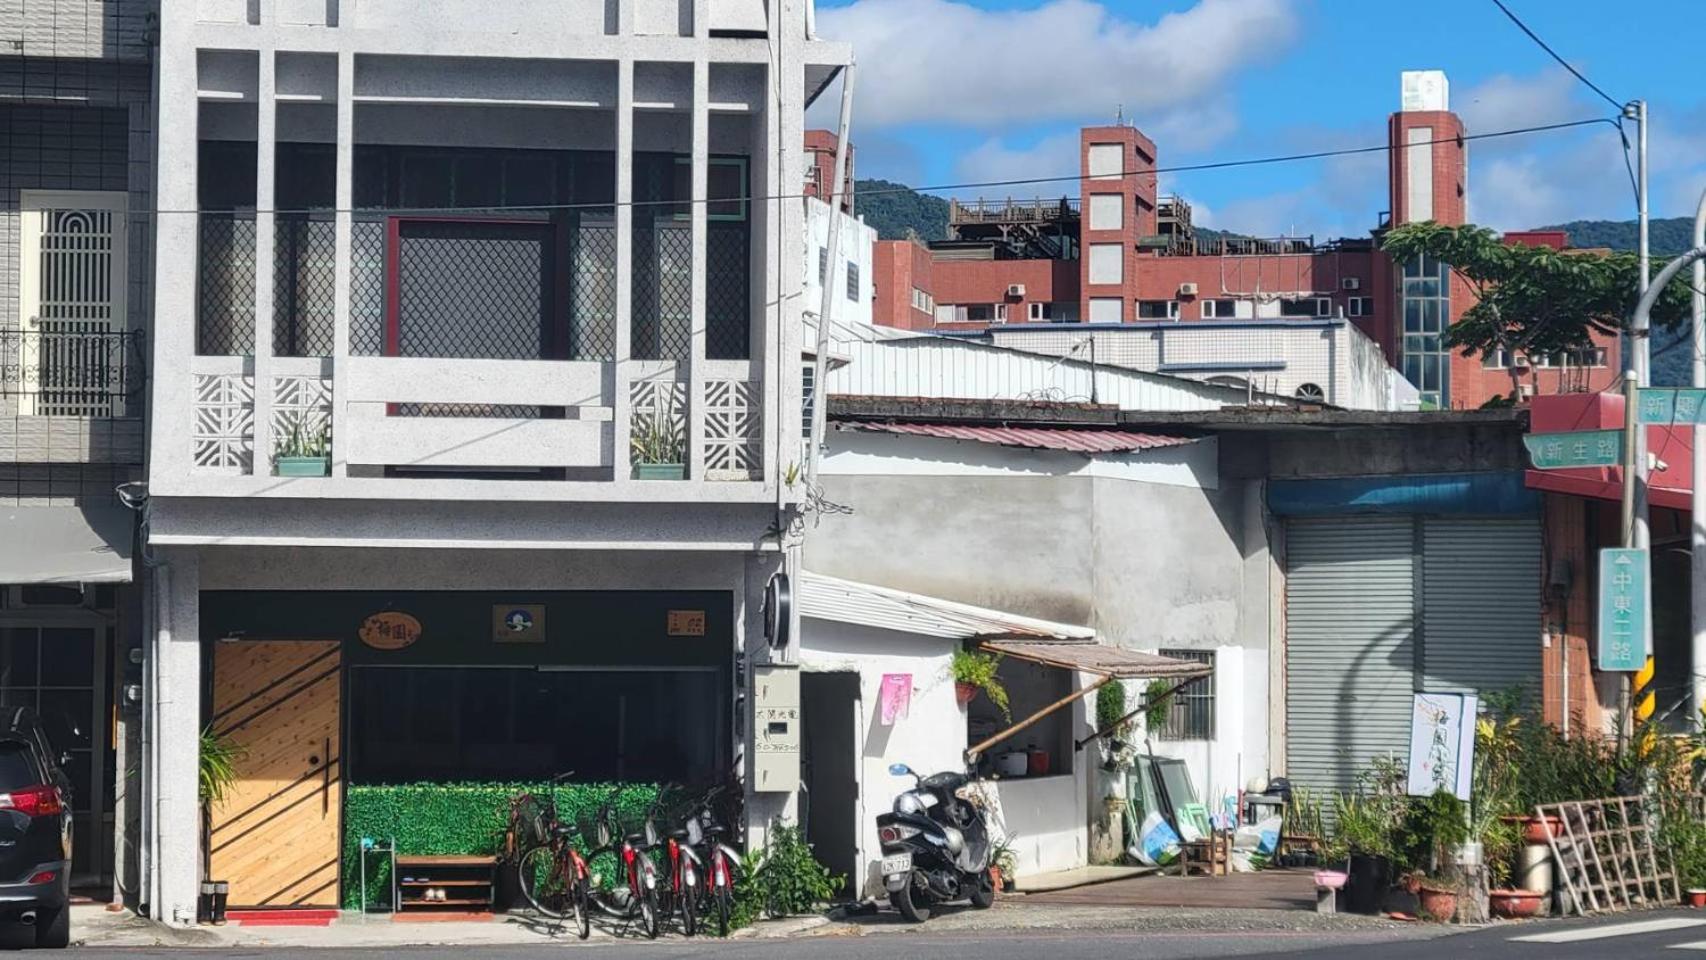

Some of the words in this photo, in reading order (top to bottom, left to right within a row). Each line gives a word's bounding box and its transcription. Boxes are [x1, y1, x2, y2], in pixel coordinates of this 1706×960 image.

[1547, 439, 1616, 460] 新生路
[1612, 571, 1632, 661] 中東二路
